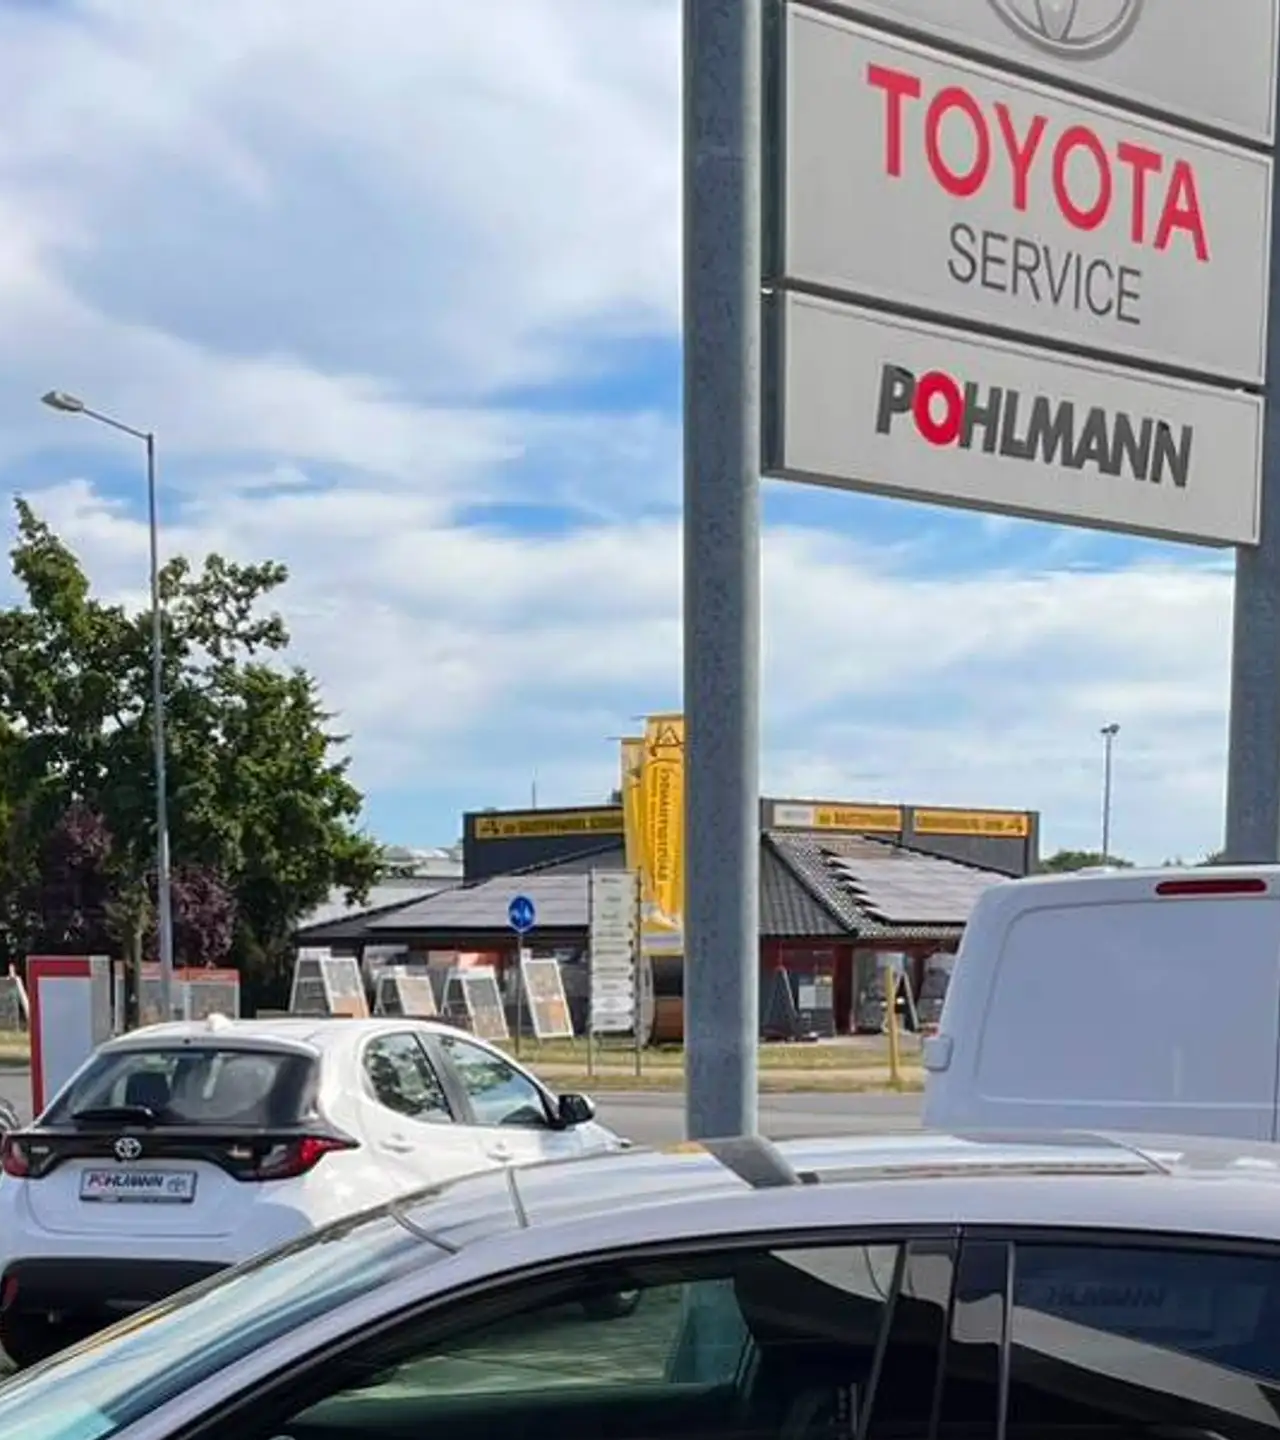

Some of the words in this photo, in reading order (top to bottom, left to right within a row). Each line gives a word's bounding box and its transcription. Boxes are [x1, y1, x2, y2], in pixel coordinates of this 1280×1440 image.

[866, 62, 1210, 262] TOYOTA
[948, 223, 1142, 325] SERVICE
[875, 363, 1193, 488] POHLMANN
